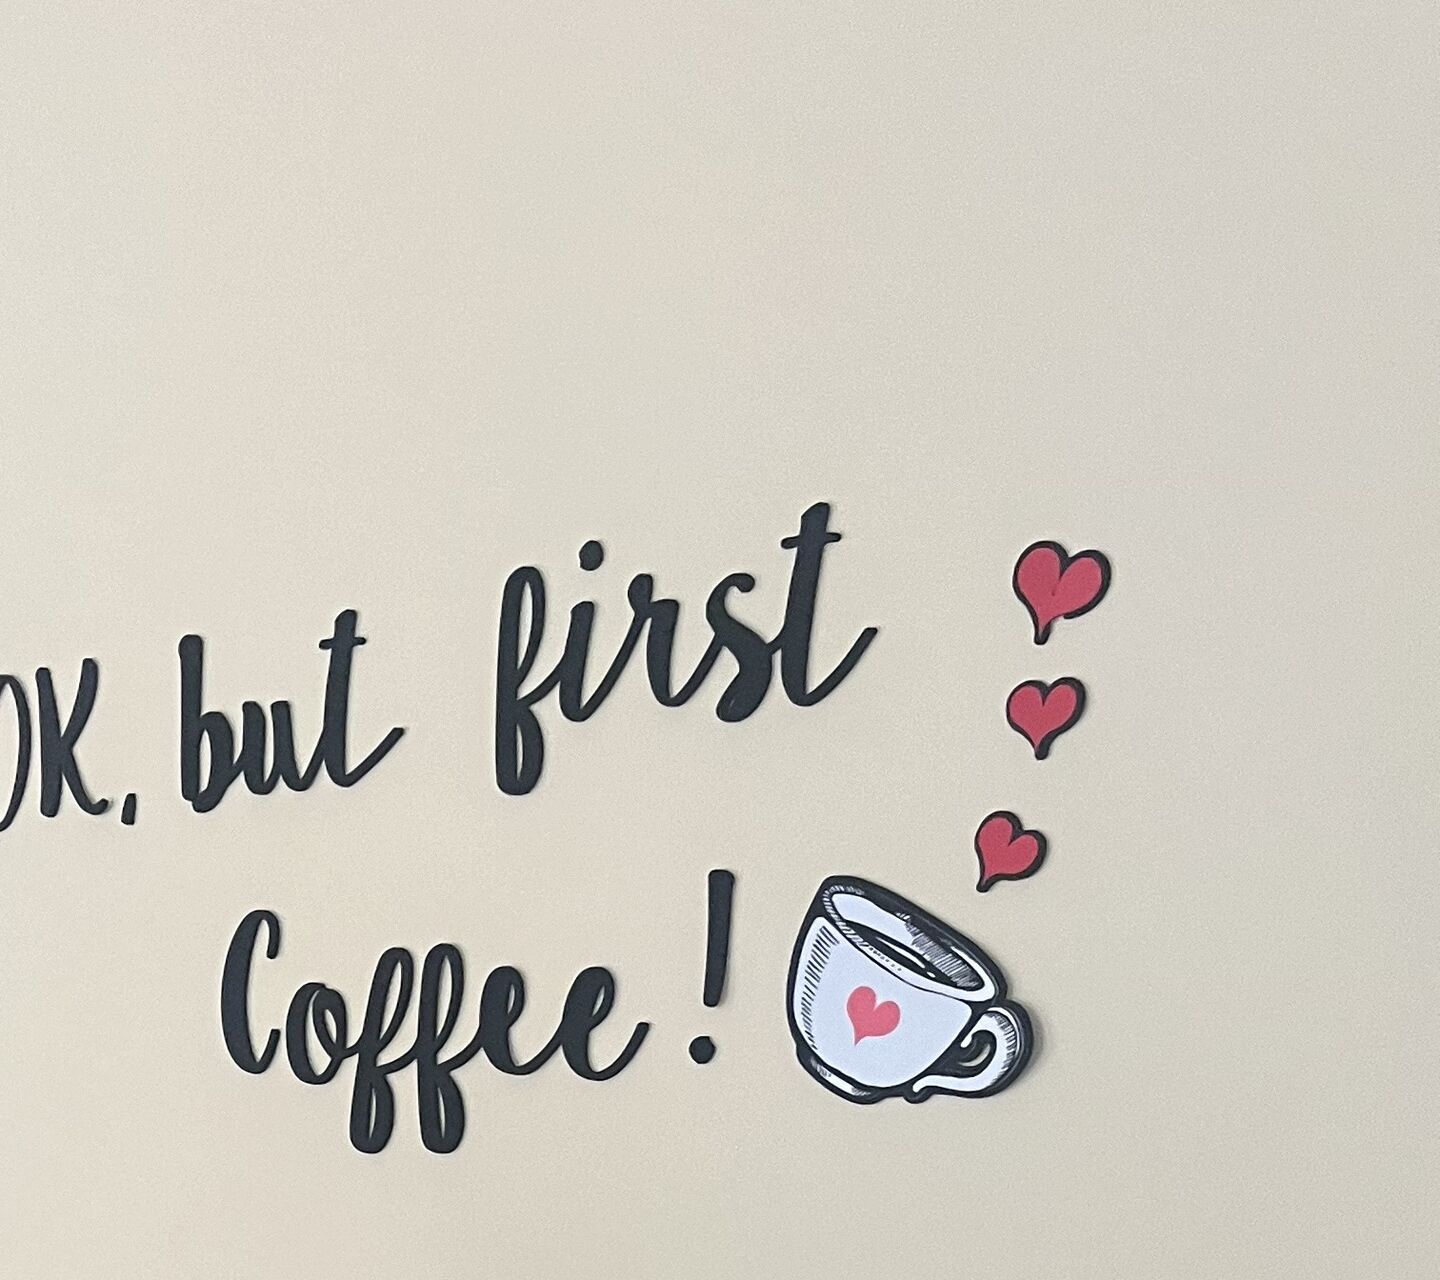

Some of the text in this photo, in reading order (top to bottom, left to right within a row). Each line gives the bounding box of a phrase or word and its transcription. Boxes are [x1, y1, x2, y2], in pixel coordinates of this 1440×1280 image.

[178, 608, 405, 814] but
[495, 501, 878, 796] first
[220, 909, 650, 1155] Coffee
